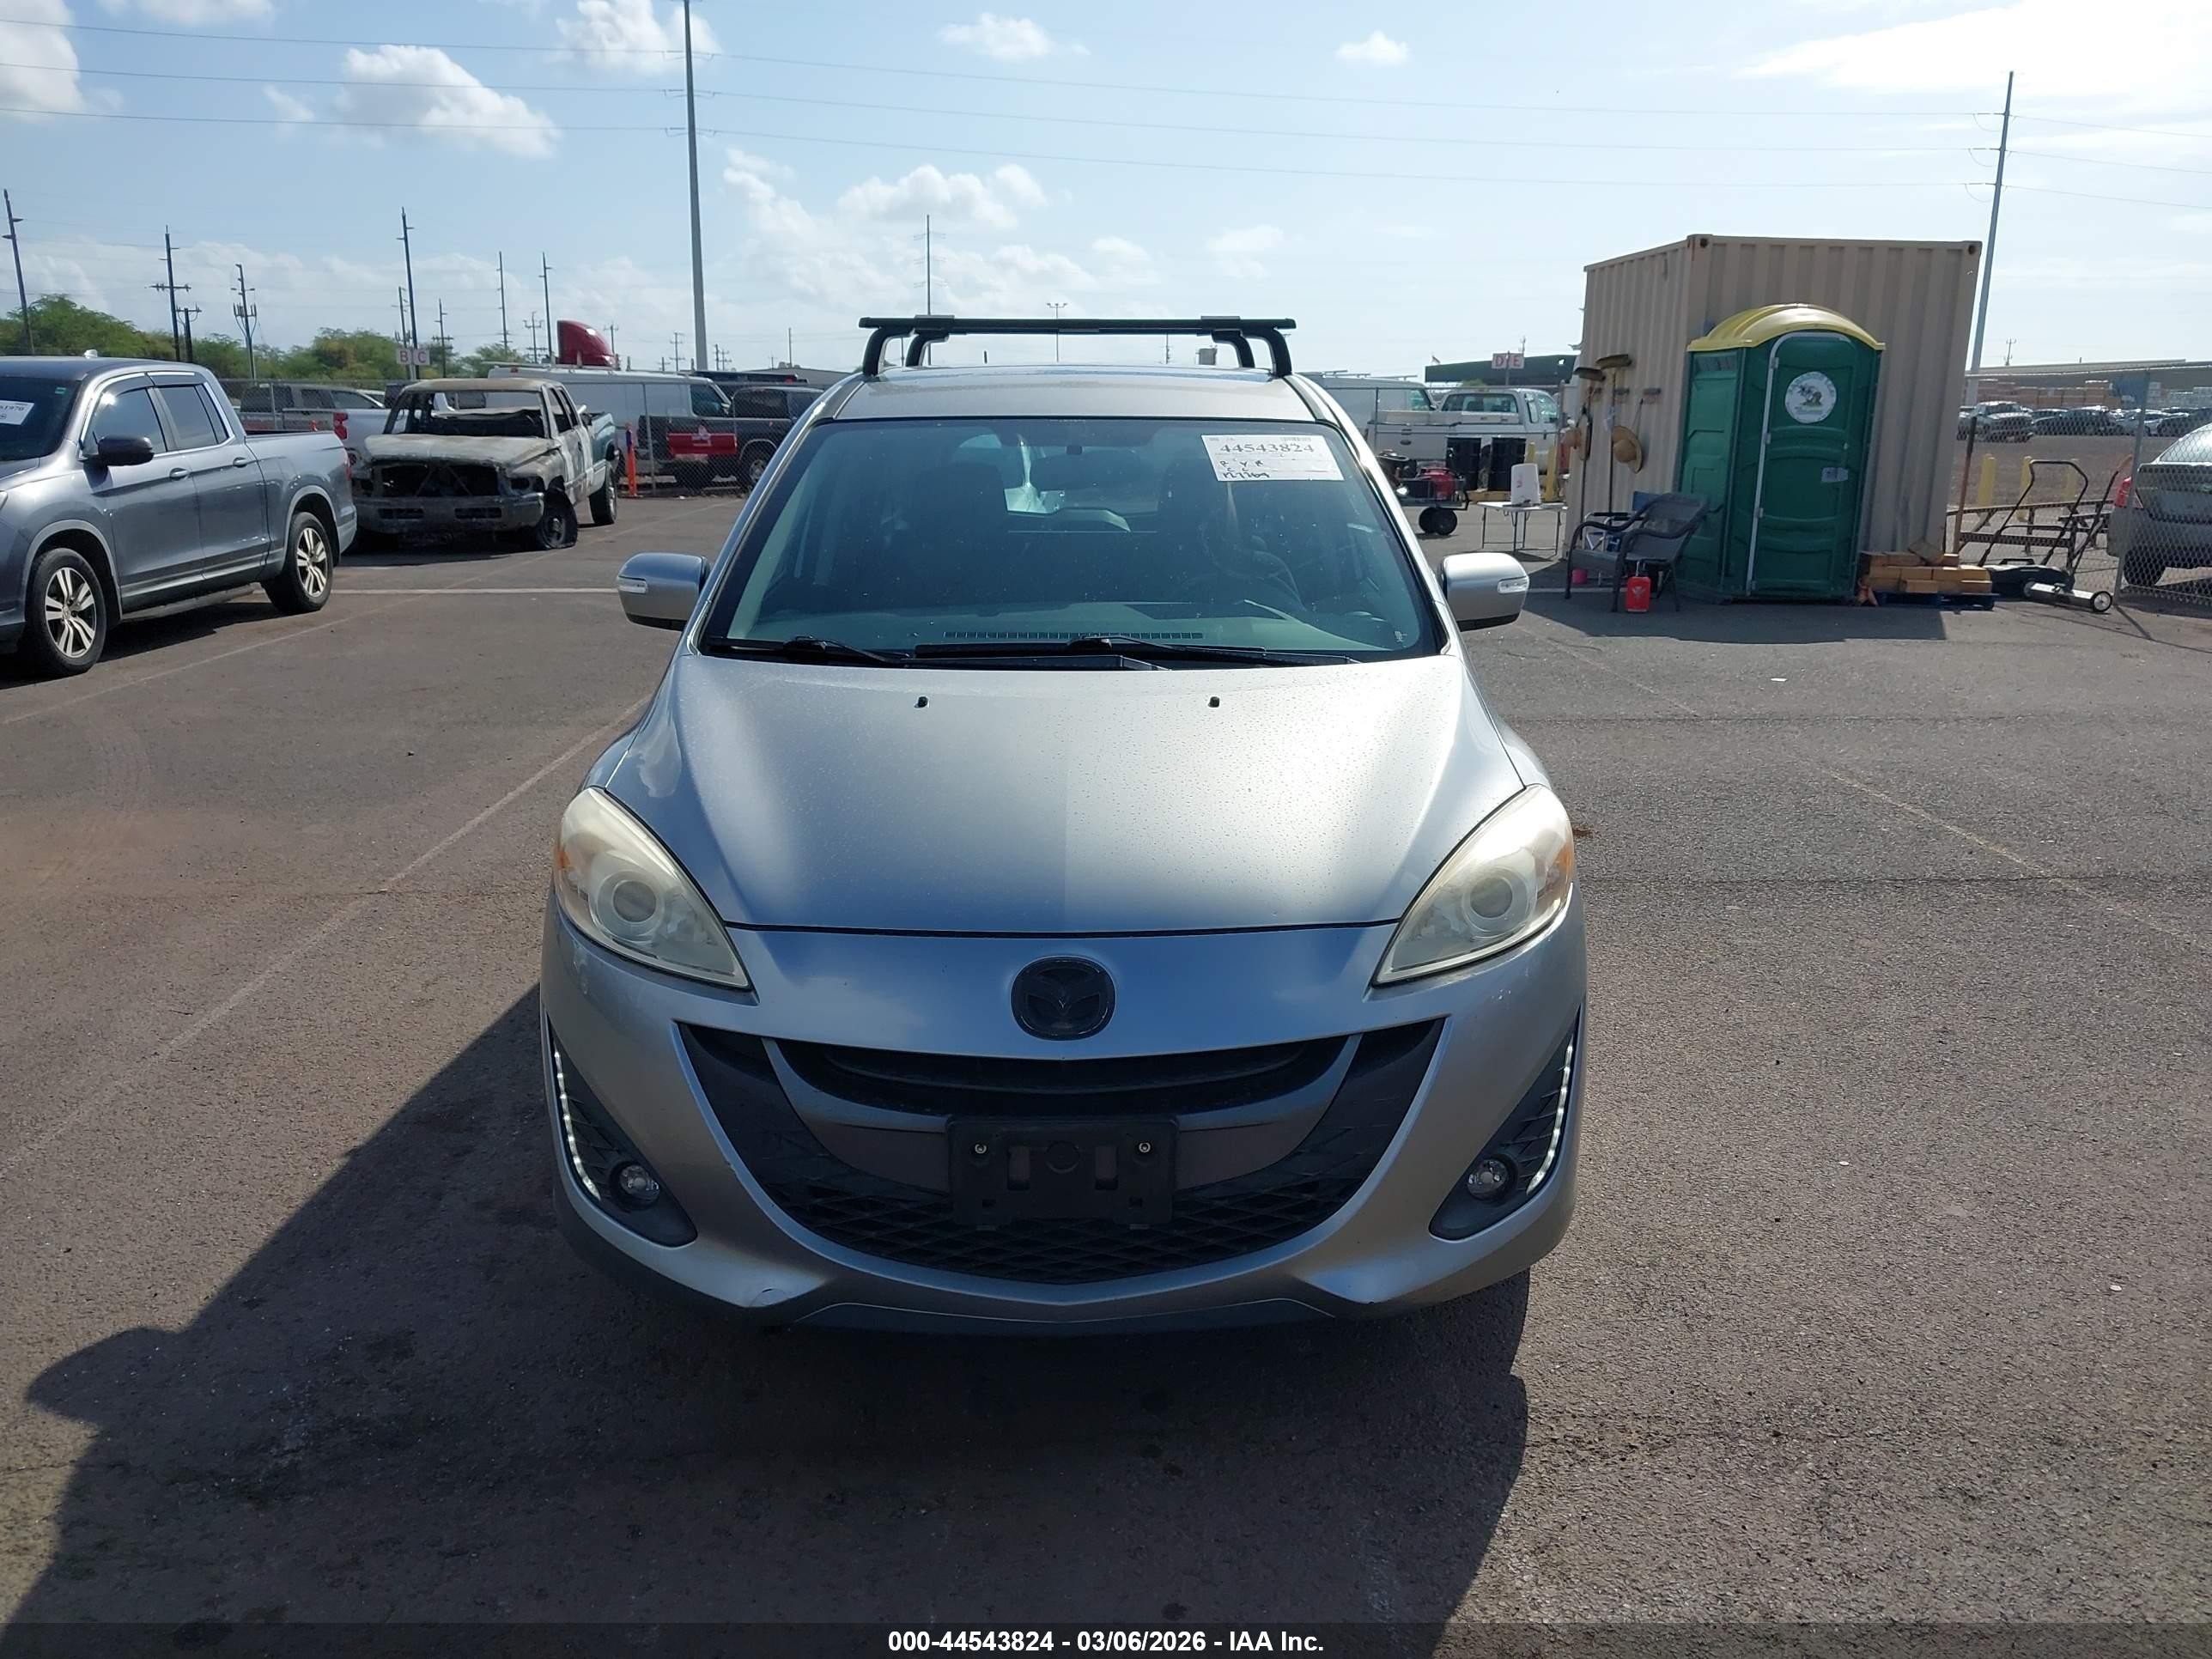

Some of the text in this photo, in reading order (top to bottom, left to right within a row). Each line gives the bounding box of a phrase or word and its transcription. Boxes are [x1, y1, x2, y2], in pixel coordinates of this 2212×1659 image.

[399, 349, 427, 363] B C
[1495, 356, 1521, 368] D E
[1220, 444, 1315, 453] 44543824
